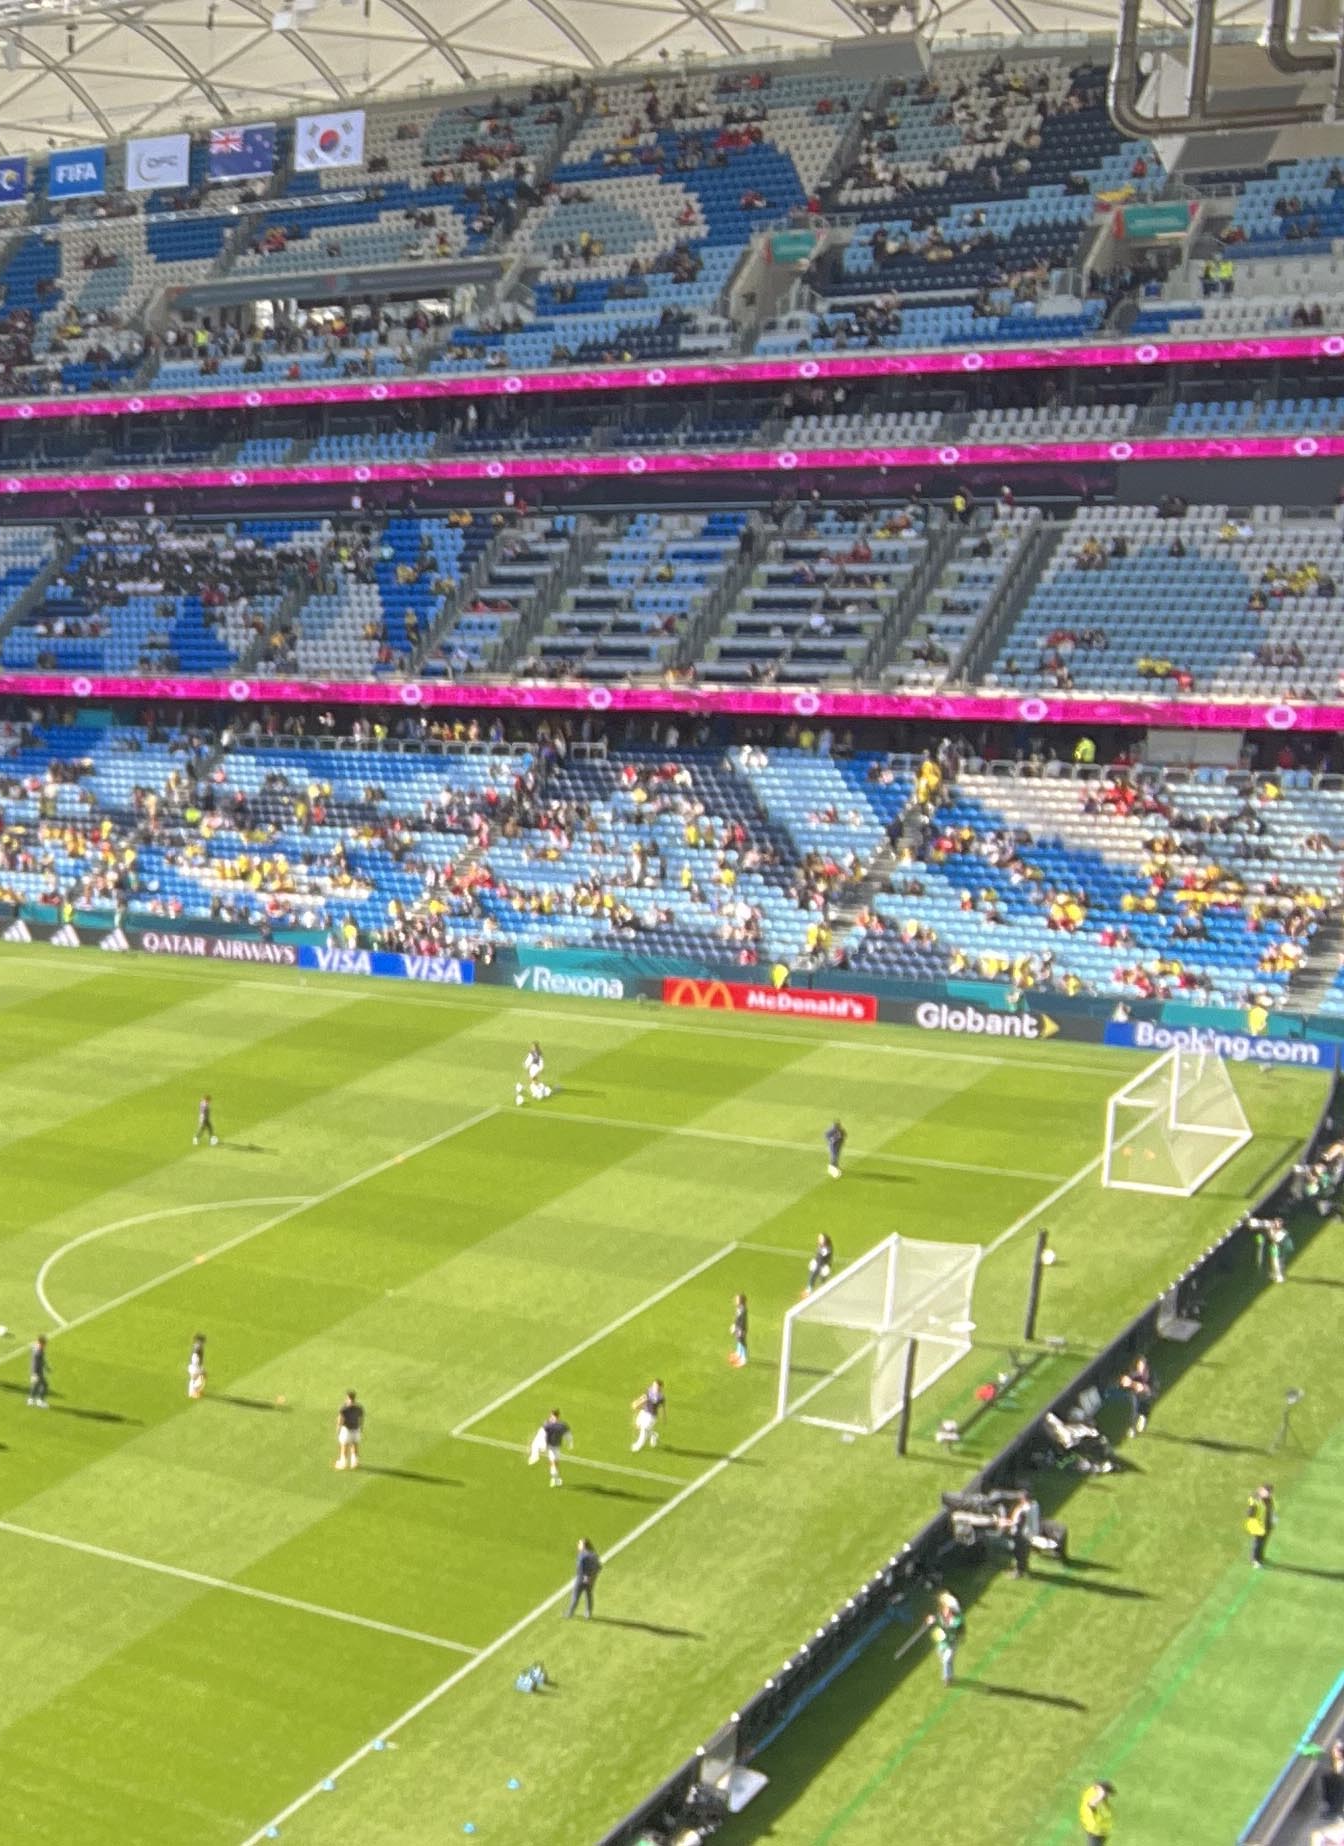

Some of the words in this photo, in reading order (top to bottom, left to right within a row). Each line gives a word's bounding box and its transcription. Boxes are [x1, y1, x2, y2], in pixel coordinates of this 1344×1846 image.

[55, 161, 98, 184] FIFA
[142, 932, 205, 956] QATAR
[212, 939, 295, 965] AIRWAYS
[317, 946, 372, 974] VISA
[403, 954, 463, 984] VISA
[532, 964, 624, 999] Rexona
[746, 989, 865, 1018] McDonald's
[916, 1002, 1039, 1038] Globant
